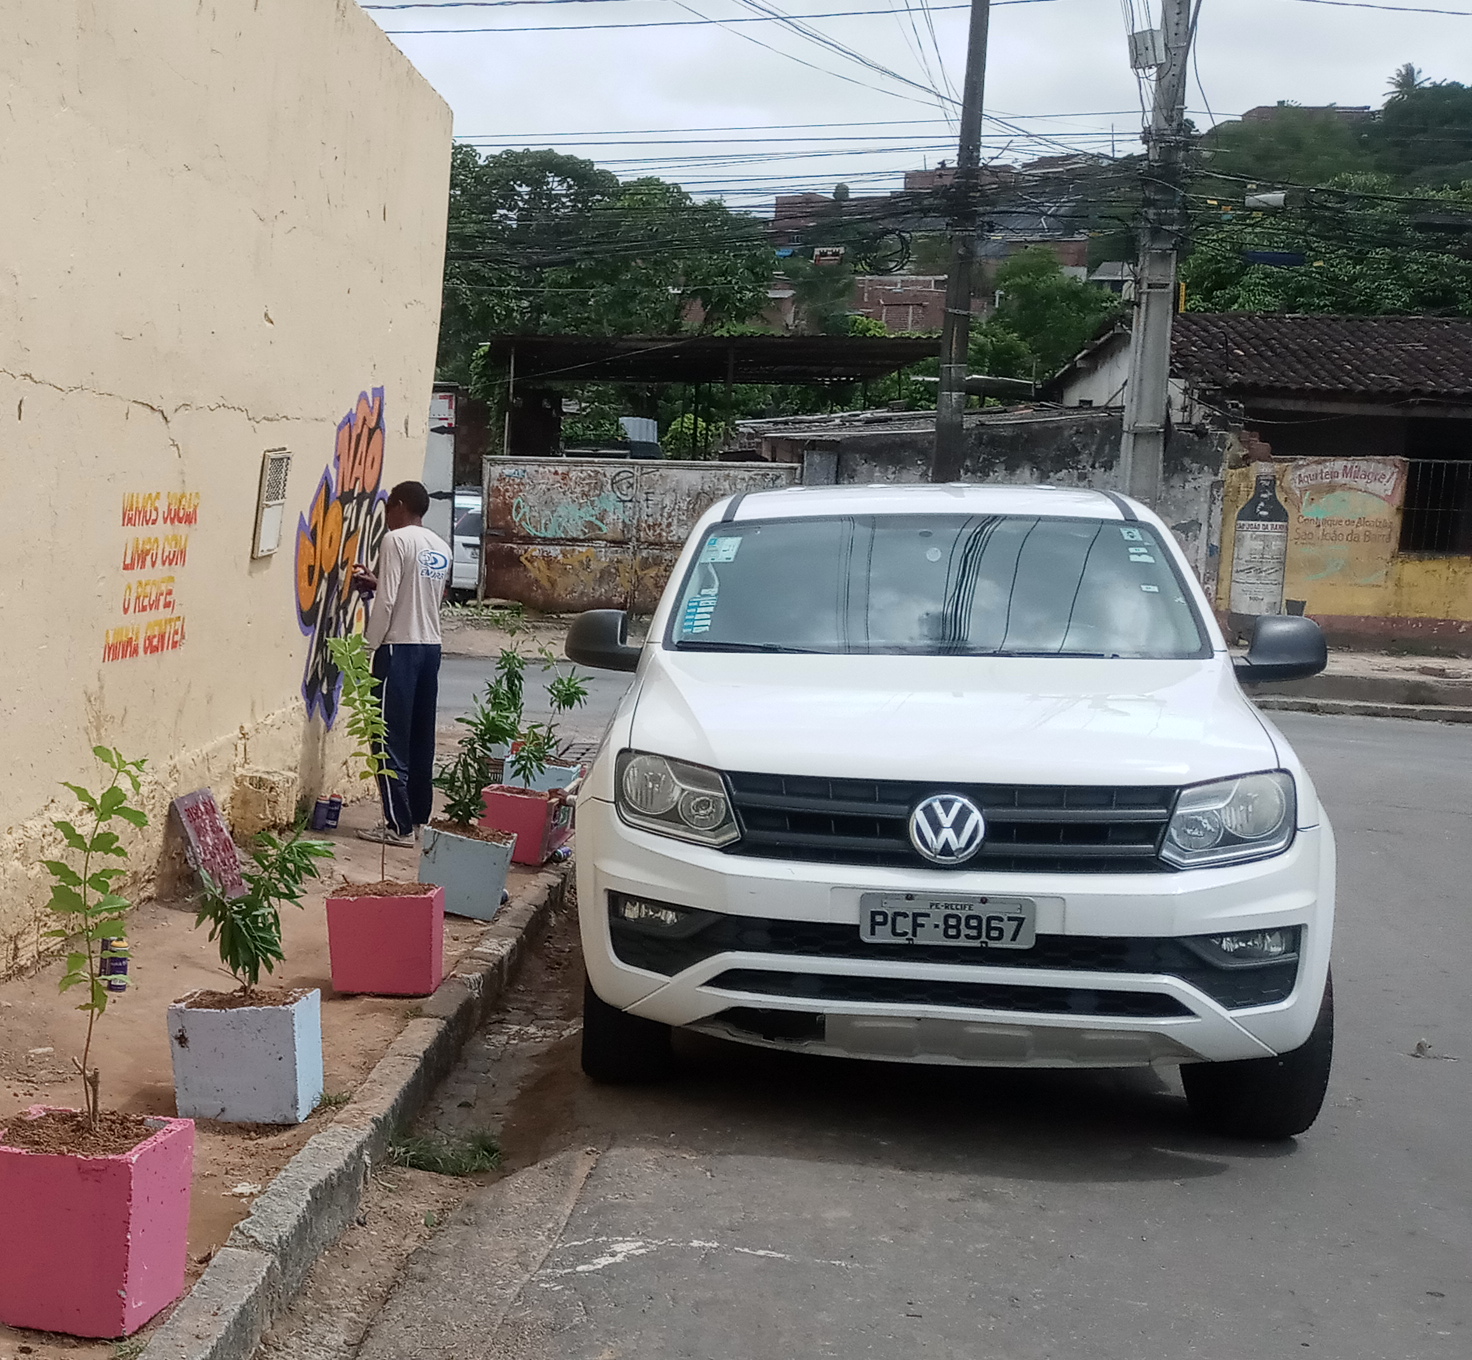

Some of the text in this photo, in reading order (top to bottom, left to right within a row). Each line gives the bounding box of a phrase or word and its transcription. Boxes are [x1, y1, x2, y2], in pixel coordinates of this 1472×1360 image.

[335, 392, 385, 499] NÃO
[1319, 468, 1339, 481] tem
[121, 491, 201, 527] VAMOS JOGAR
[122, 533, 189, 571] LIMPO COM
[1346, 528, 1360, 542] da
[122, 575, 177, 615] O RECIFE,
[102, 624, 140, 663] MINHA
[929, 902, 974, 911] PE-RECIFE
